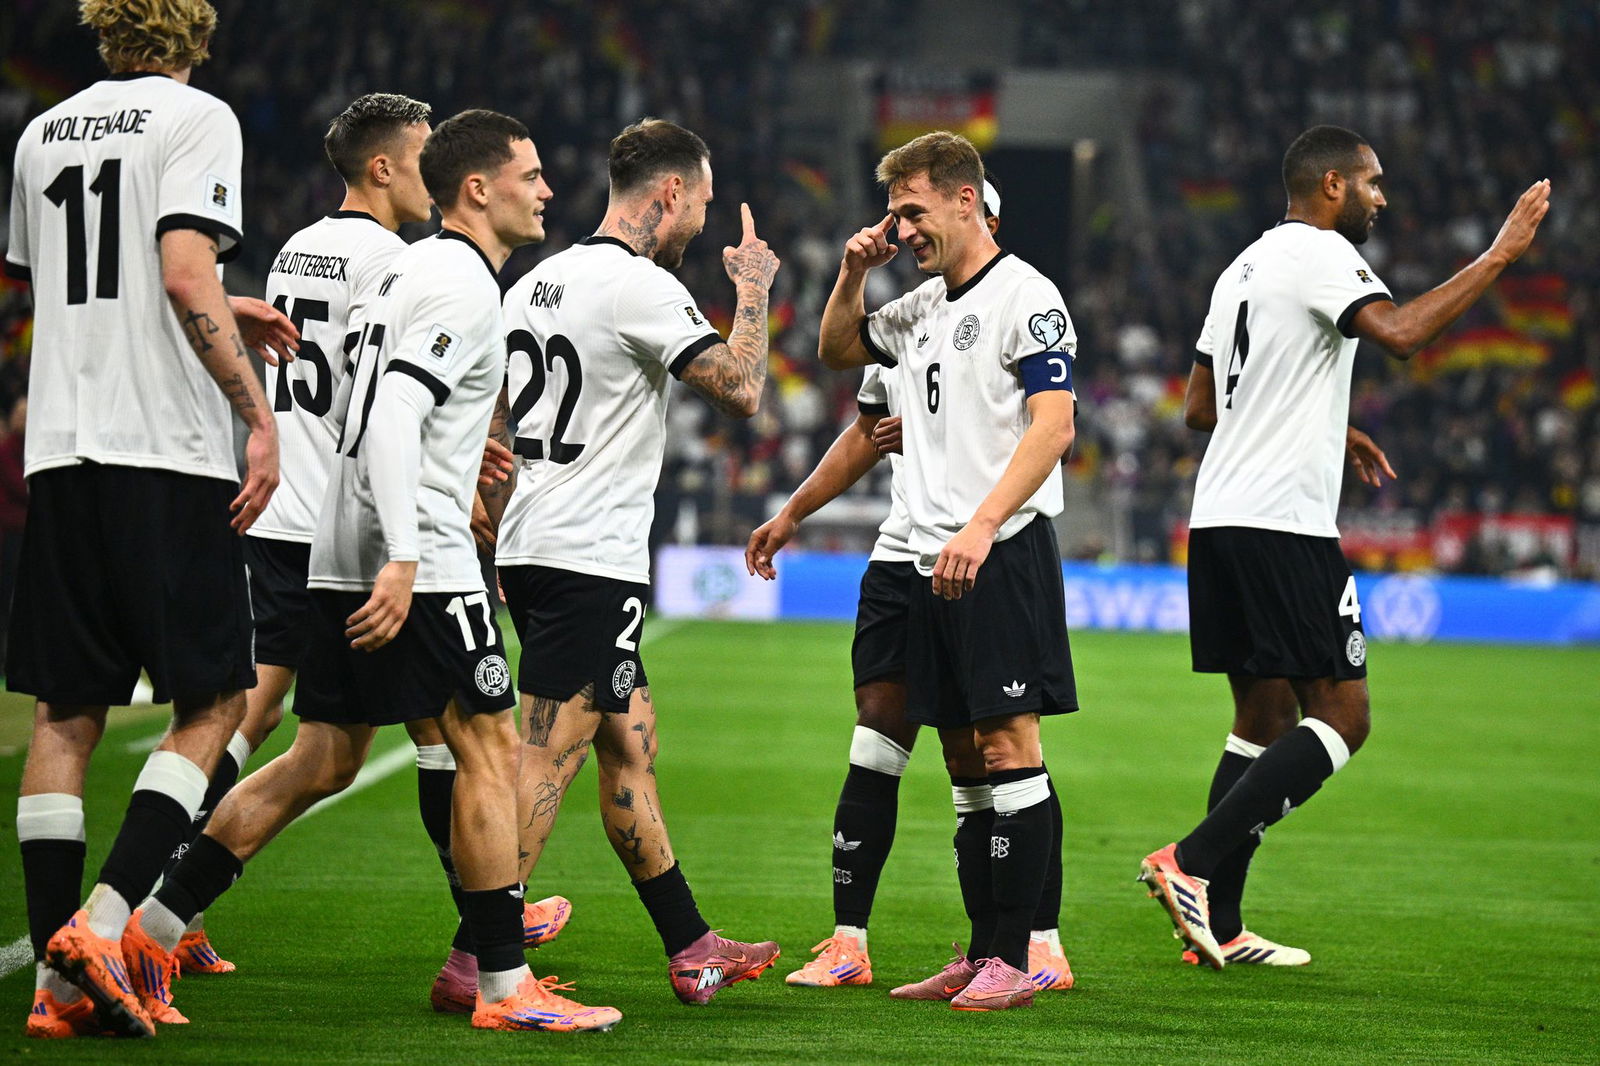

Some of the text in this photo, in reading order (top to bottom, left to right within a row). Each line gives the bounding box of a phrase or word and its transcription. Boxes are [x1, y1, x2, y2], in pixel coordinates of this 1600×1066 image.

[42, 158, 121, 305] 11
[272, 294, 332, 417] 15
[1047, 358, 1067, 383] C
[1225, 300, 1249, 409] 4
[507, 329, 586, 464] 22
[926, 363, 941, 414] 6
[445, 591, 496, 651] 17
[615, 597, 647, 651] 2
[1338, 575, 1362, 623] 4
